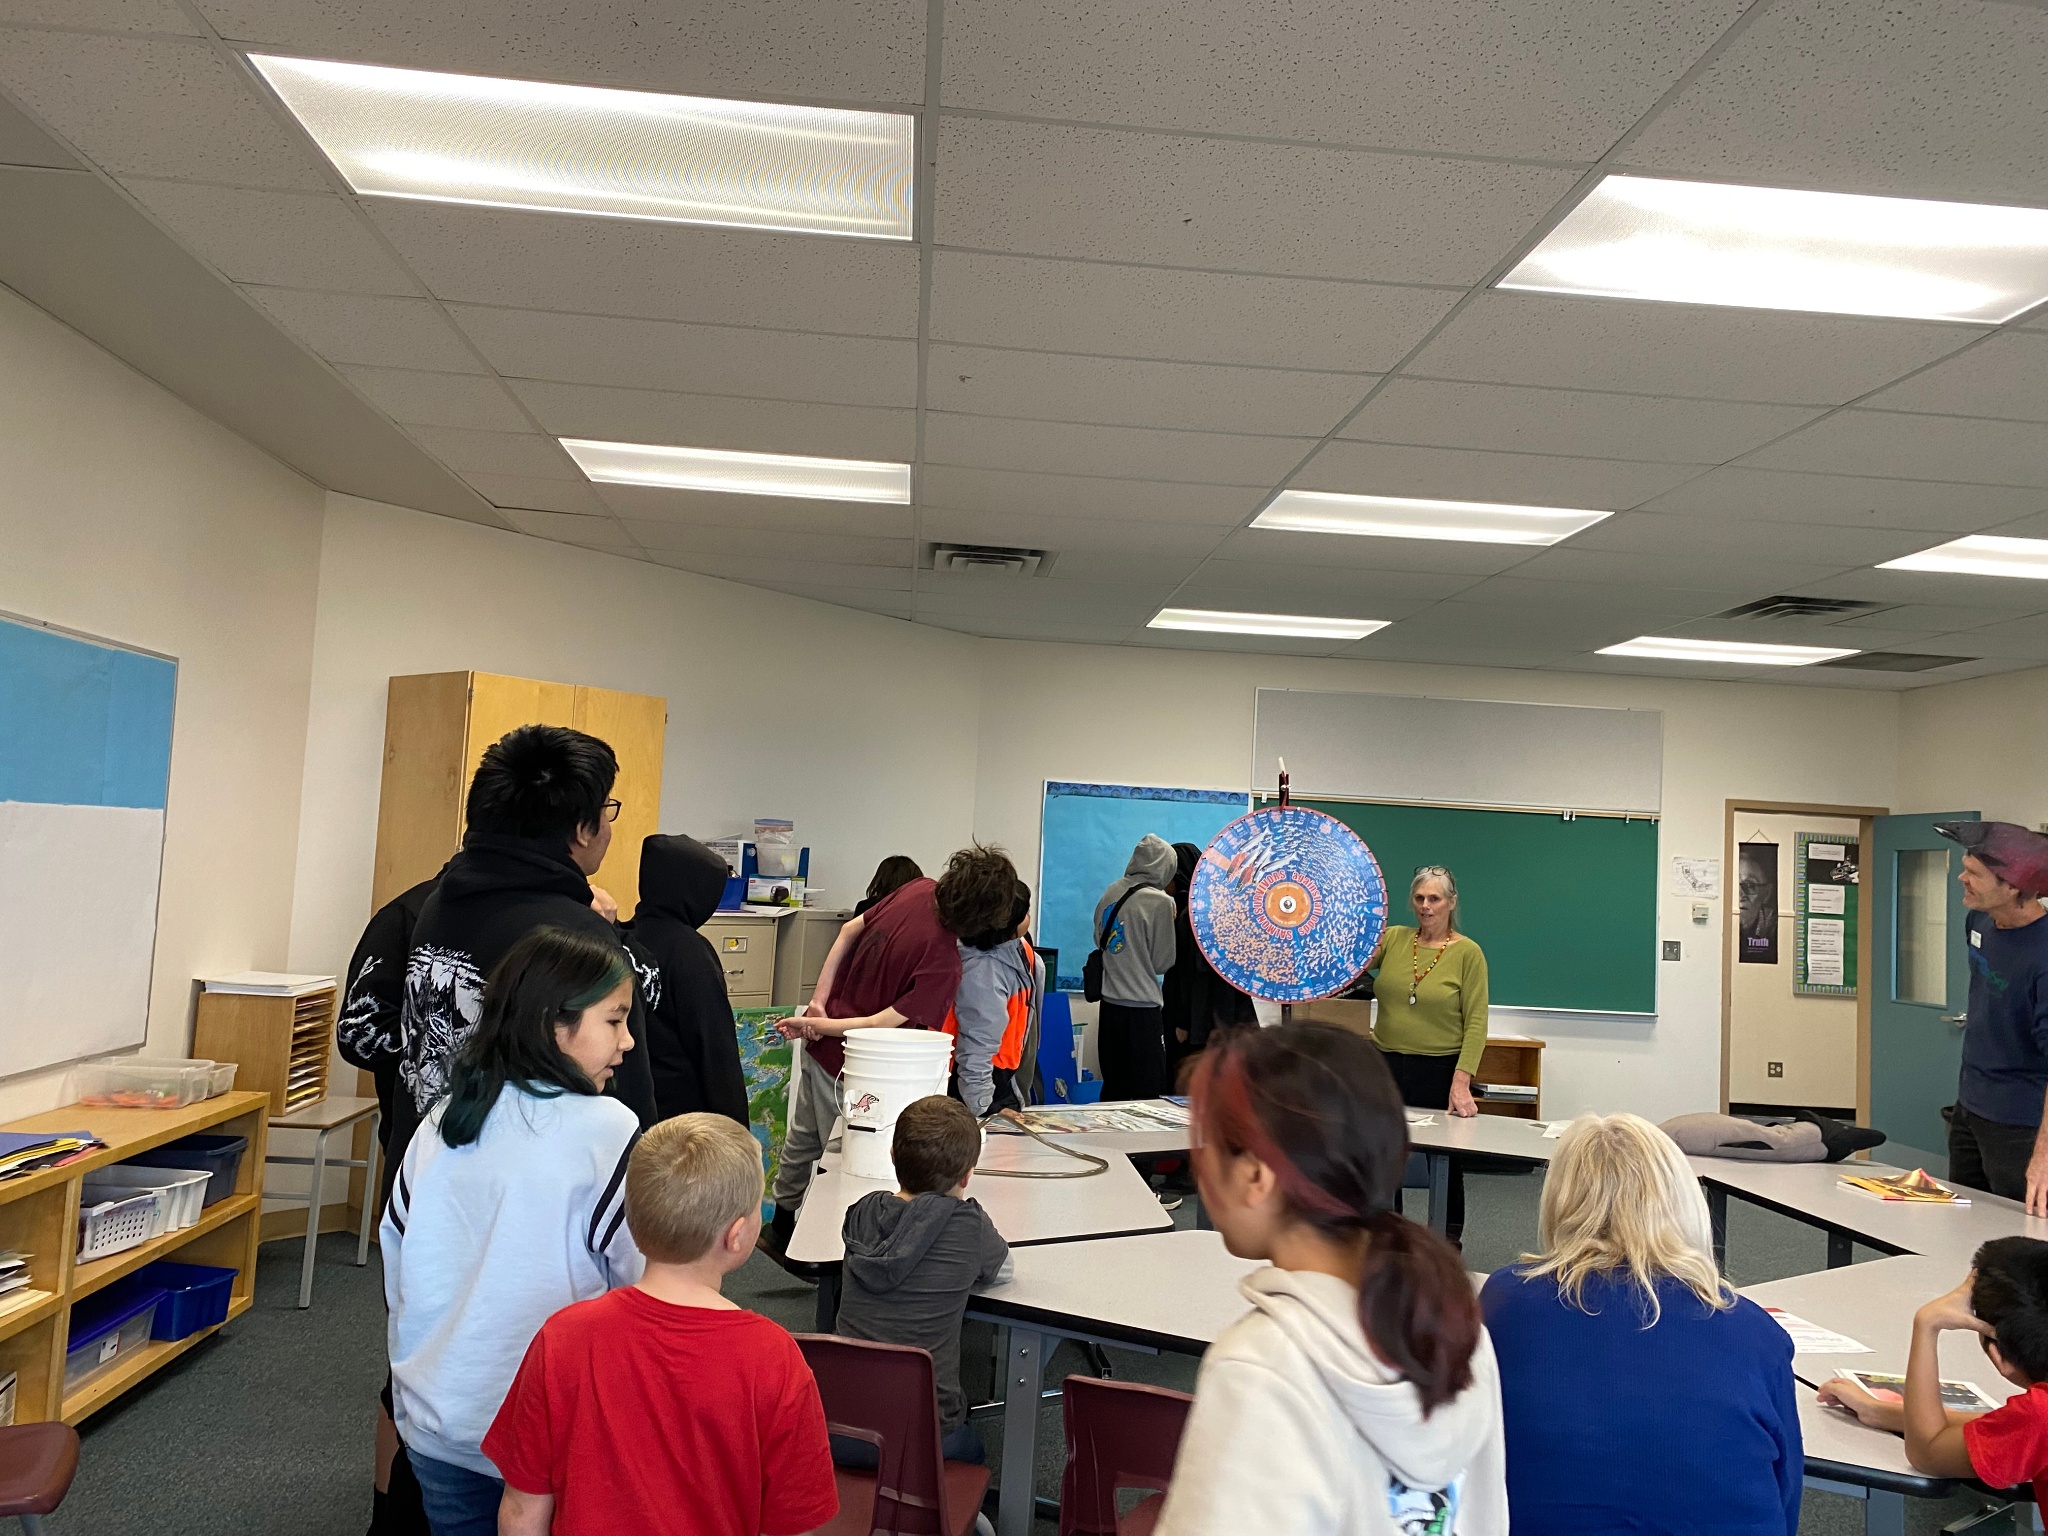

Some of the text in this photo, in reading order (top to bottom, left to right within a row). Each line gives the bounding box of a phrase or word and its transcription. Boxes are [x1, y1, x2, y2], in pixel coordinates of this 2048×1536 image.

[1253, 870, 1286, 915] SURVIVORS
[1292, 872, 1322, 901] against
[1313, 902, 1323, 916] all
[1256, 914, 1293, 940] SALMON
[1298, 915, 1319, 936] odds
[1747, 937, 1769, 947] Truth
